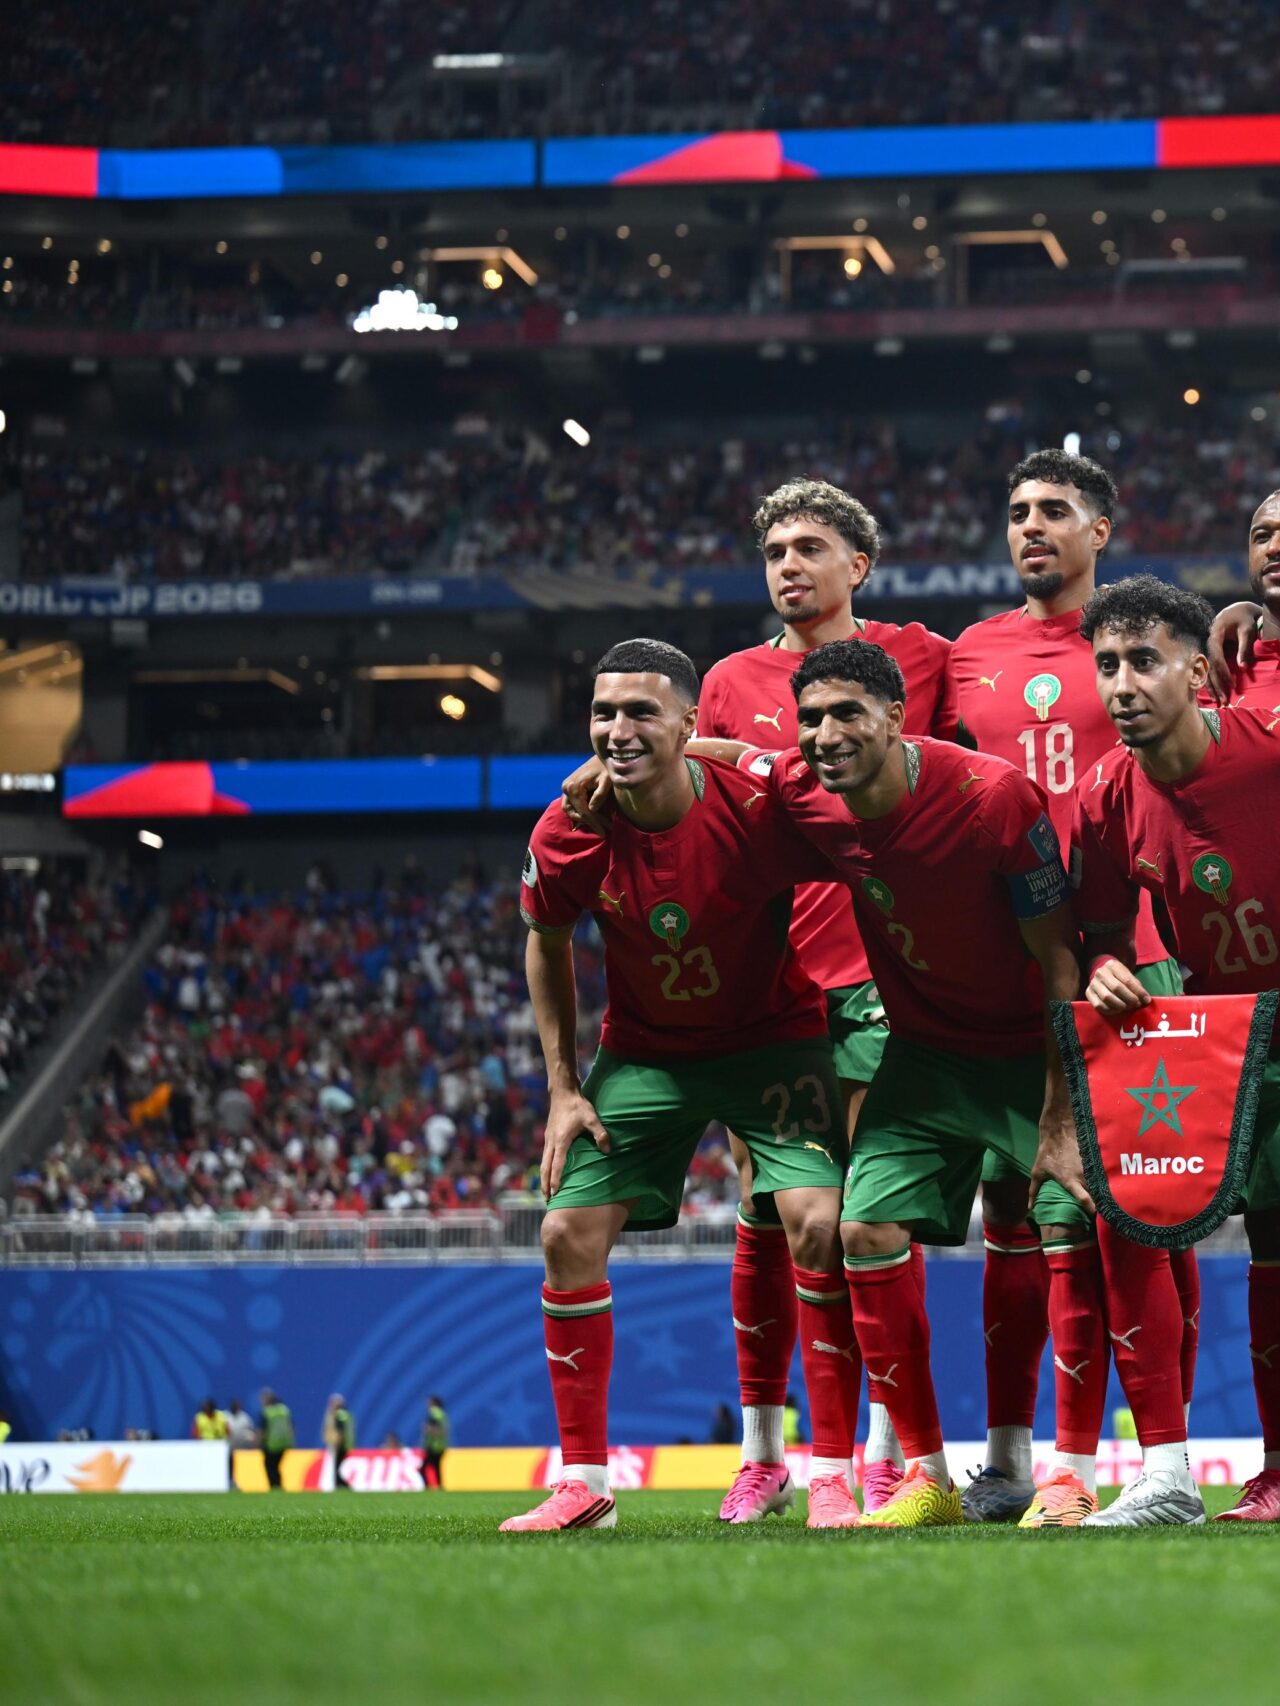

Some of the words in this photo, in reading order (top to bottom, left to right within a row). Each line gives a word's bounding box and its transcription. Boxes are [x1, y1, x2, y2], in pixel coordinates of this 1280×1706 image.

[155, 582, 263, 615] 2026
[1017, 722, 1075, 794] 18
[887, 921, 930, 970] 2
[1201, 897, 1279, 974] 26
[651, 945, 721, 1001] 23
[1119, 1012, 1207, 1047] المغرب
[761, 1074, 832, 1144] 23
[1120, 1153, 1205, 1175] Maroc
